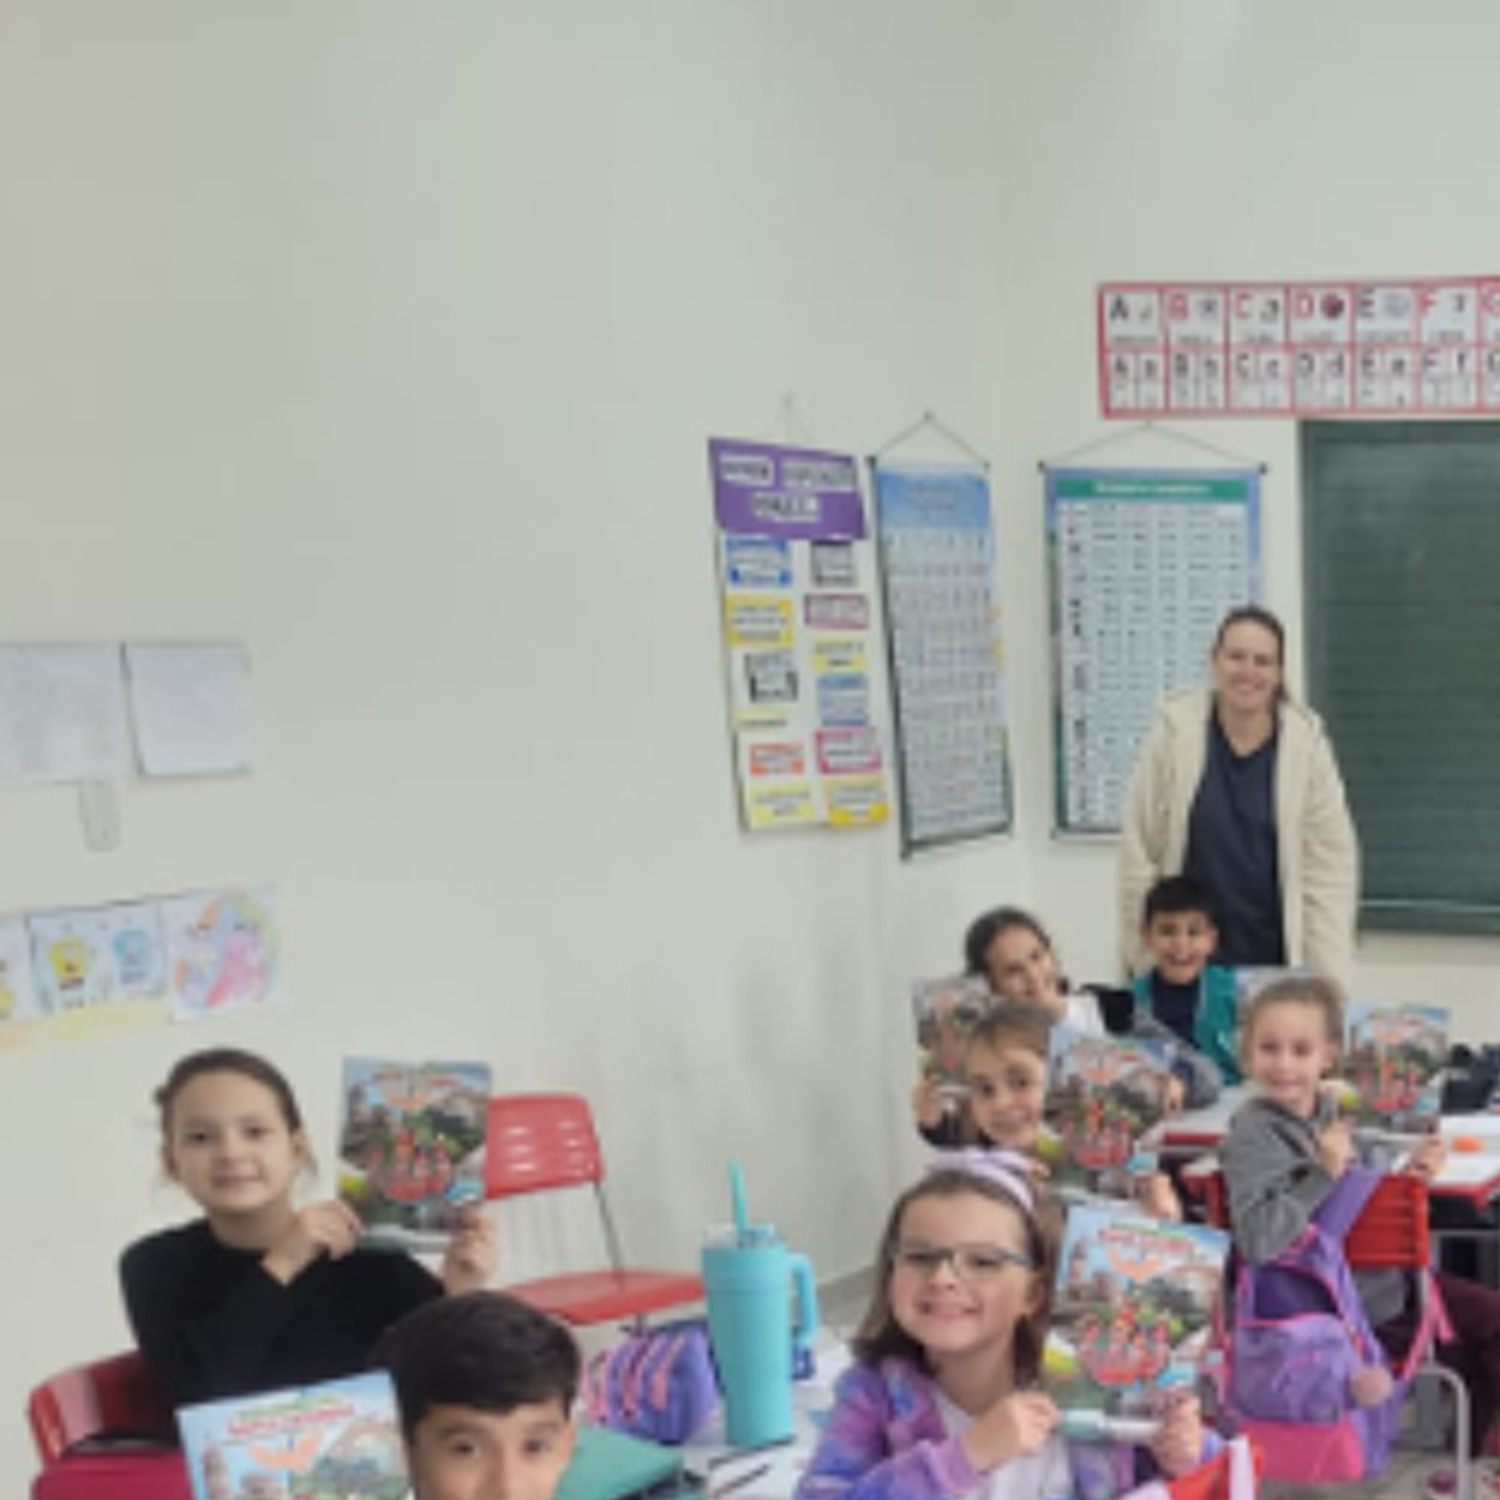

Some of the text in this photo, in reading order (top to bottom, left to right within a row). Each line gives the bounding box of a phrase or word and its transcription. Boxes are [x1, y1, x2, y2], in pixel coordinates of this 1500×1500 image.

[1109, 295, 1129, 320] A
[1168, 293, 1189, 319] B
[1235, 292, 1252, 319] C
[1295, 292, 1315, 319] D
[1357, 287, 1374, 318] E
[1418, 286, 1436, 315] F
